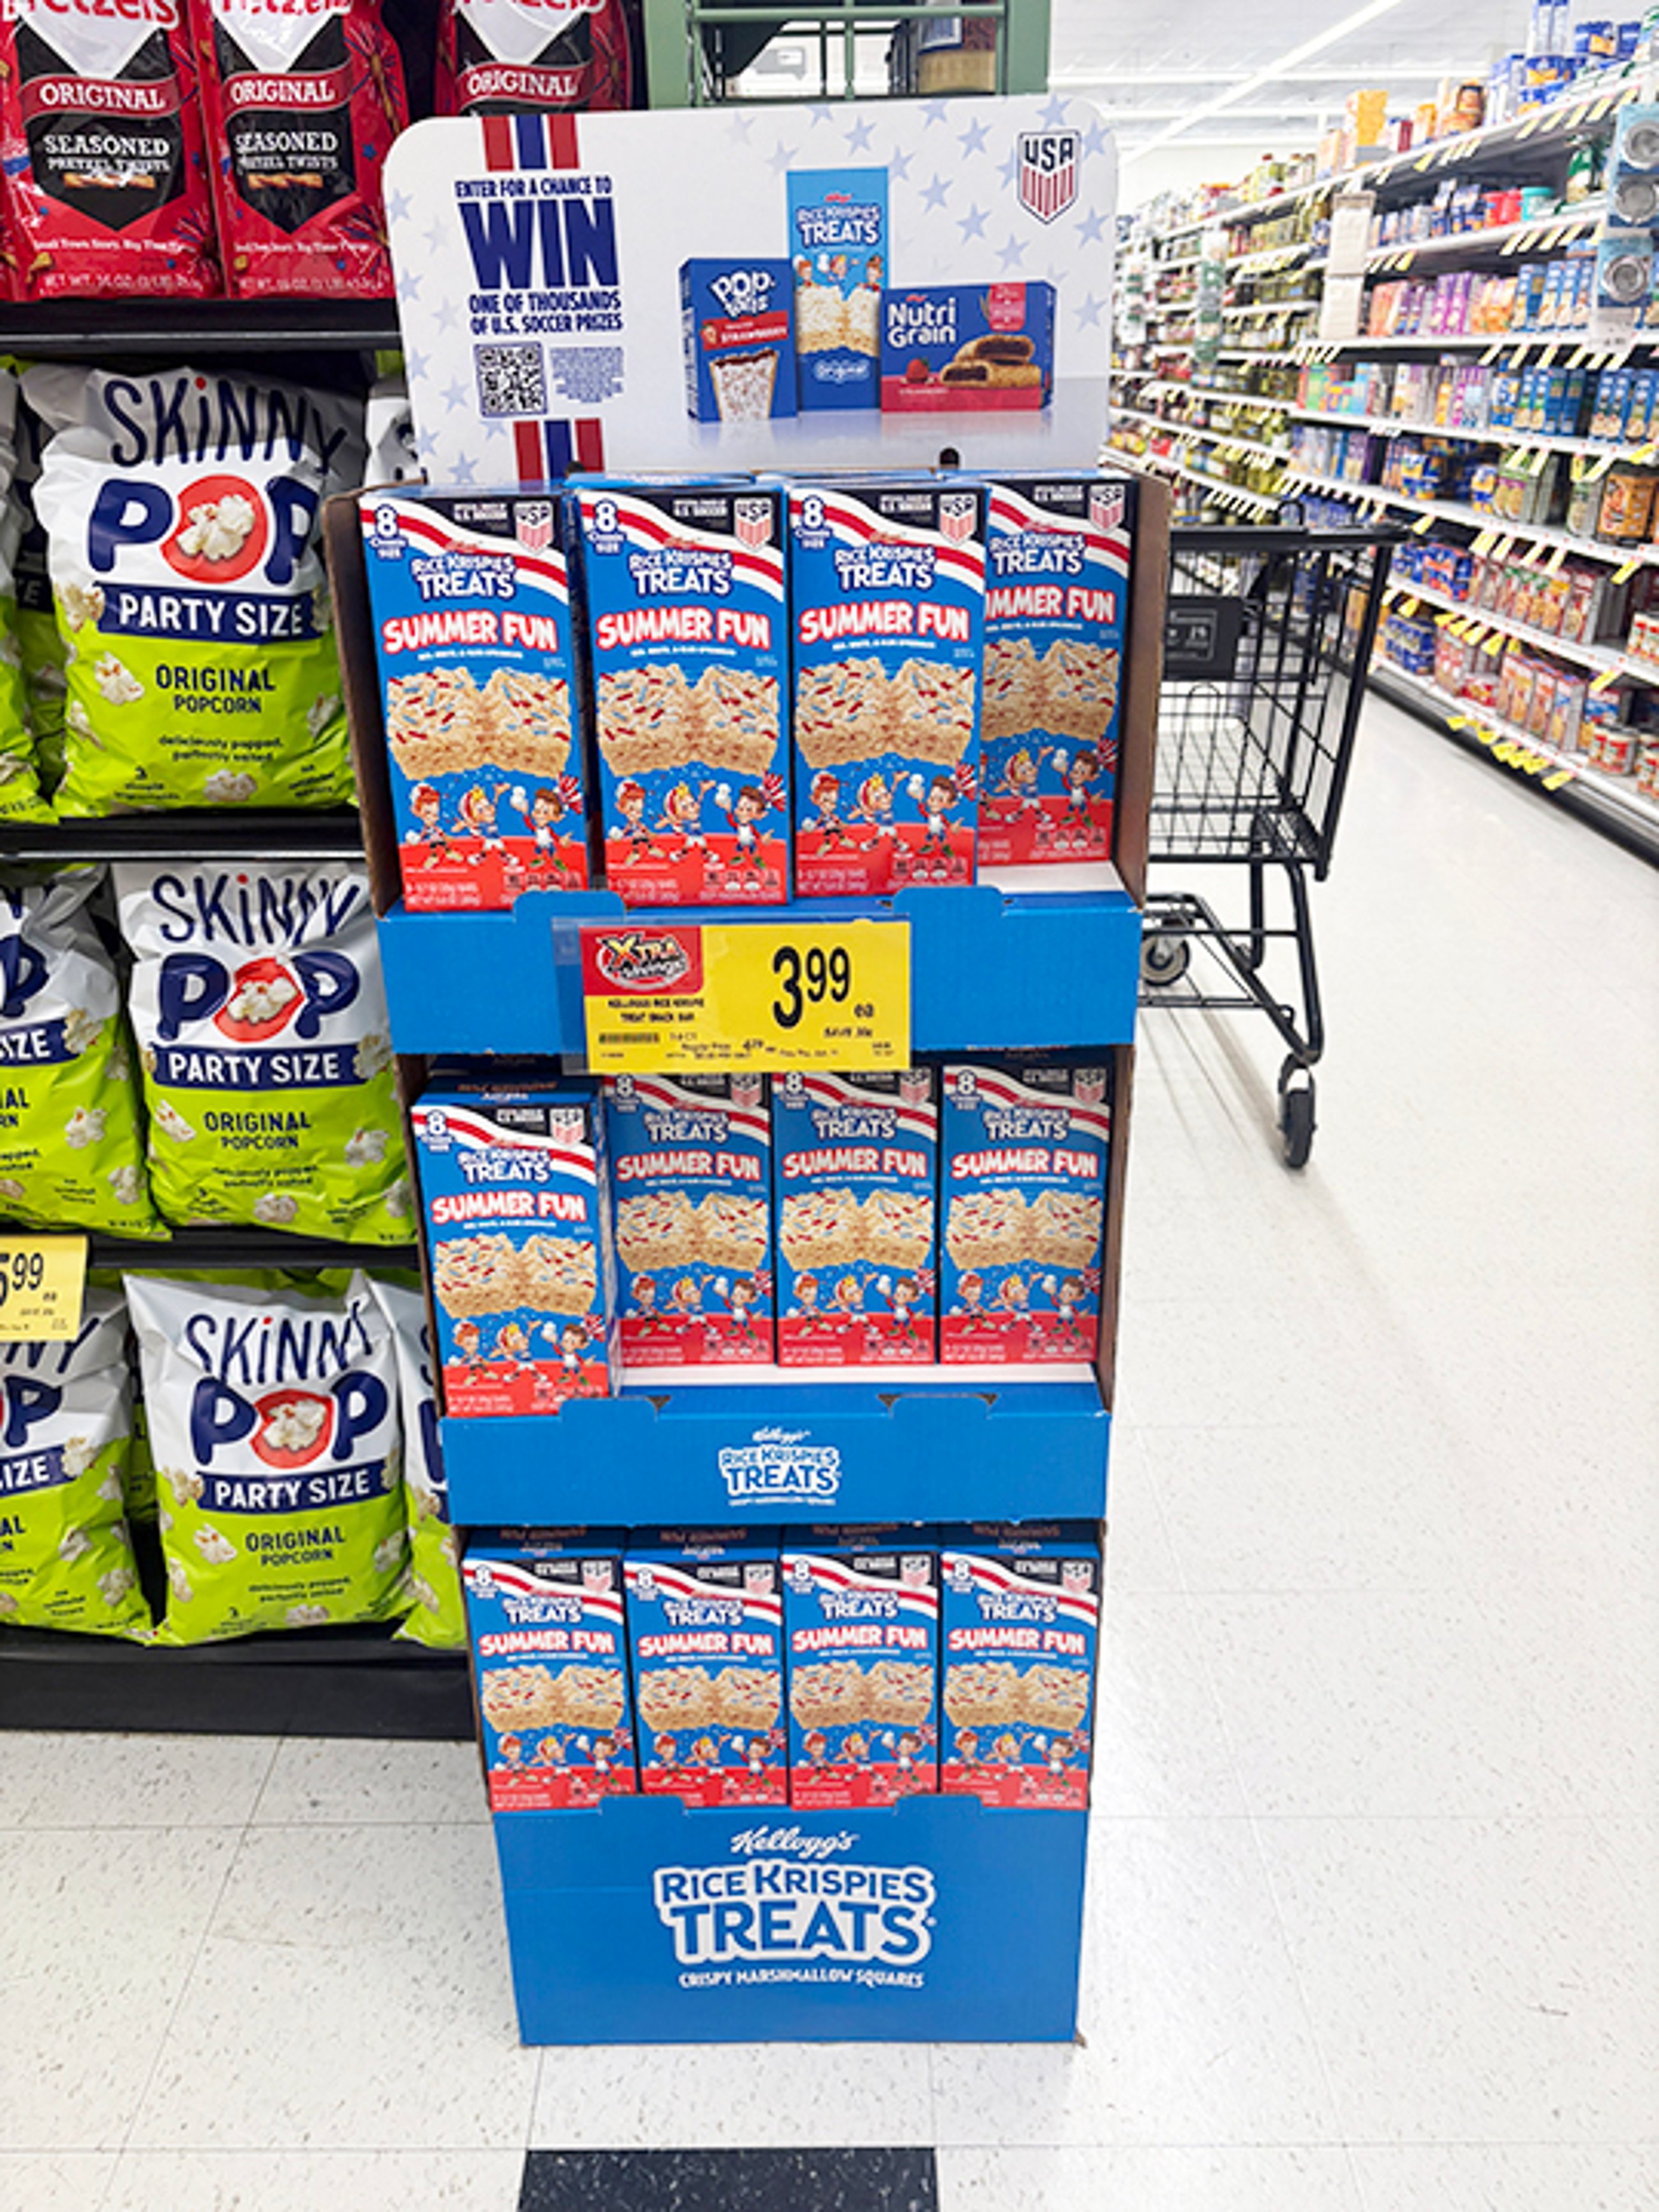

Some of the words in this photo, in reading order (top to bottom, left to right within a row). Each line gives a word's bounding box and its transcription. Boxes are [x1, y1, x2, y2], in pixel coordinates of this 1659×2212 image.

[40, 83, 166, 109] ORIGINAL
[230, 81, 336, 103] ORIGINAL
[466, 70, 578, 97] ORIGINAL
[43, 134, 170, 156] SEASONED
[235, 131, 338, 154] SEASONED
[1023, 138, 1075, 172] USA
[455, 181, 497, 197] ENTER
[501, 179, 525, 197] FOR
[529, 178, 538, 195] A
[540, 177, 592, 195] CHANCE
[595, 176, 613, 194] TO
[458, 198, 618, 288] WIN
[801, 221, 879, 246] TREATS
[469, 294, 500, 313] ONE
[503, 293, 524, 313] OF
[528, 290, 622, 311] THOUSANDS
[888, 297, 956, 327] Nutri
[471, 317, 487, 334] OF
[491, 316, 519, 334] U.S.
[523, 315, 572, 333] SOCCER
[577, 313, 623, 332] PRIZES
[888, 325, 956, 348] Grain
[376, 504, 398, 539] 8
[595, 500, 616, 534] 8
[803, 497, 824, 529] 8
[88, 474, 319, 585] POP
[993, 548, 1083, 576] TREATS
[417, 570, 515, 601] TREATS
[634, 567, 731, 596] TREATS
[837, 562, 934, 591] TREATS
[119, 595, 225, 633] PARTY
[235, 605, 303, 637] SIZE
[985, 585, 1064, 622] MMER
[1066, 585, 1117, 625] FUN
[382, 609, 498, 655] SUMMER
[501, 610, 559, 654] FUN
[596, 606, 713, 650] SUMMER
[716, 607, 771, 650] FUN
[798, 600, 915, 645] SUMMER
[916, 601, 971, 644] FUN
[156, 664, 276, 692] ORIGINAL
[174, 695, 262, 715] POPCORN
[156, 951, 361, 1043] POP
[854, 1003, 874, 1019] ea
[168, 1052, 263, 1084] PARTY
[270, 1052, 340, 1080] SIZE
[958, 1072, 976, 1093] 8
[202, 1111, 311, 1133] ORIGINAL
[428, 1110, 446, 1135] 8
[648, 1123, 728, 1143] TREATS
[815, 1118, 895, 1139] TREATS
[987, 1119, 1068, 1140] TREATS
[220, 1135, 299, 1150] POPCORN
[465, 1160, 549, 1183] TREATS
[616, 1150, 713, 1182] SUMMER
[716, 1151, 761, 1181] FUN
[782, 1146, 879, 1179] SUMMER
[882, 1147, 928, 1178] FUN
[951, 1147, 1050, 1179] SUMMER
[1053, 1147, 1099, 1178] FUN
[431, 1190, 535, 1225] SUMMER
[537, 1191, 588, 1223] FUN
[190, 1370, 389, 1470] POP
[0, 1454, 50, 1489] IZE
[726, 1464, 836, 1491] TREATS
[214, 1481, 303, 1509] PARTY
[309, 1469, 370, 1500] SIZE
[245, 1526, 345, 1552] ORIGINAL
[260, 1548, 333, 1566] POPCORN
[507, 1606, 582, 1624] TREATS
[667, 1609, 743, 1626] TREATS
[822, 1603, 898, 1620] TREATS
[981, 1604, 1057, 1624] TREATS
[478, 1629, 570, 1657] SUMMER
[571, 1629, 616, 1655] FUN
[638, 1631, 729, 1657] SUMMER
[730, 1632, 775, 1656] FUN
[791, 1625, 884, 1653] SUMMER
[885, 1625, 928, 1650] FUN
[948, 1626, 1039, 1654] SUMMER
[1043, 1628, 1085, 1656] FUN
[729, 1825, 860, 1859] Kellogg's
[659, 1868, 747, 1904] RICE
[752, 1863, 932, 1904] KRISPIES
[669, 1899, 923, 1957] TREATS
[678, 1970, 733, 1989] CRISPY
[736, 1965, 855, 1986] MARSHMALLOW
[856, 1968, 925, 1989] SQUARES
